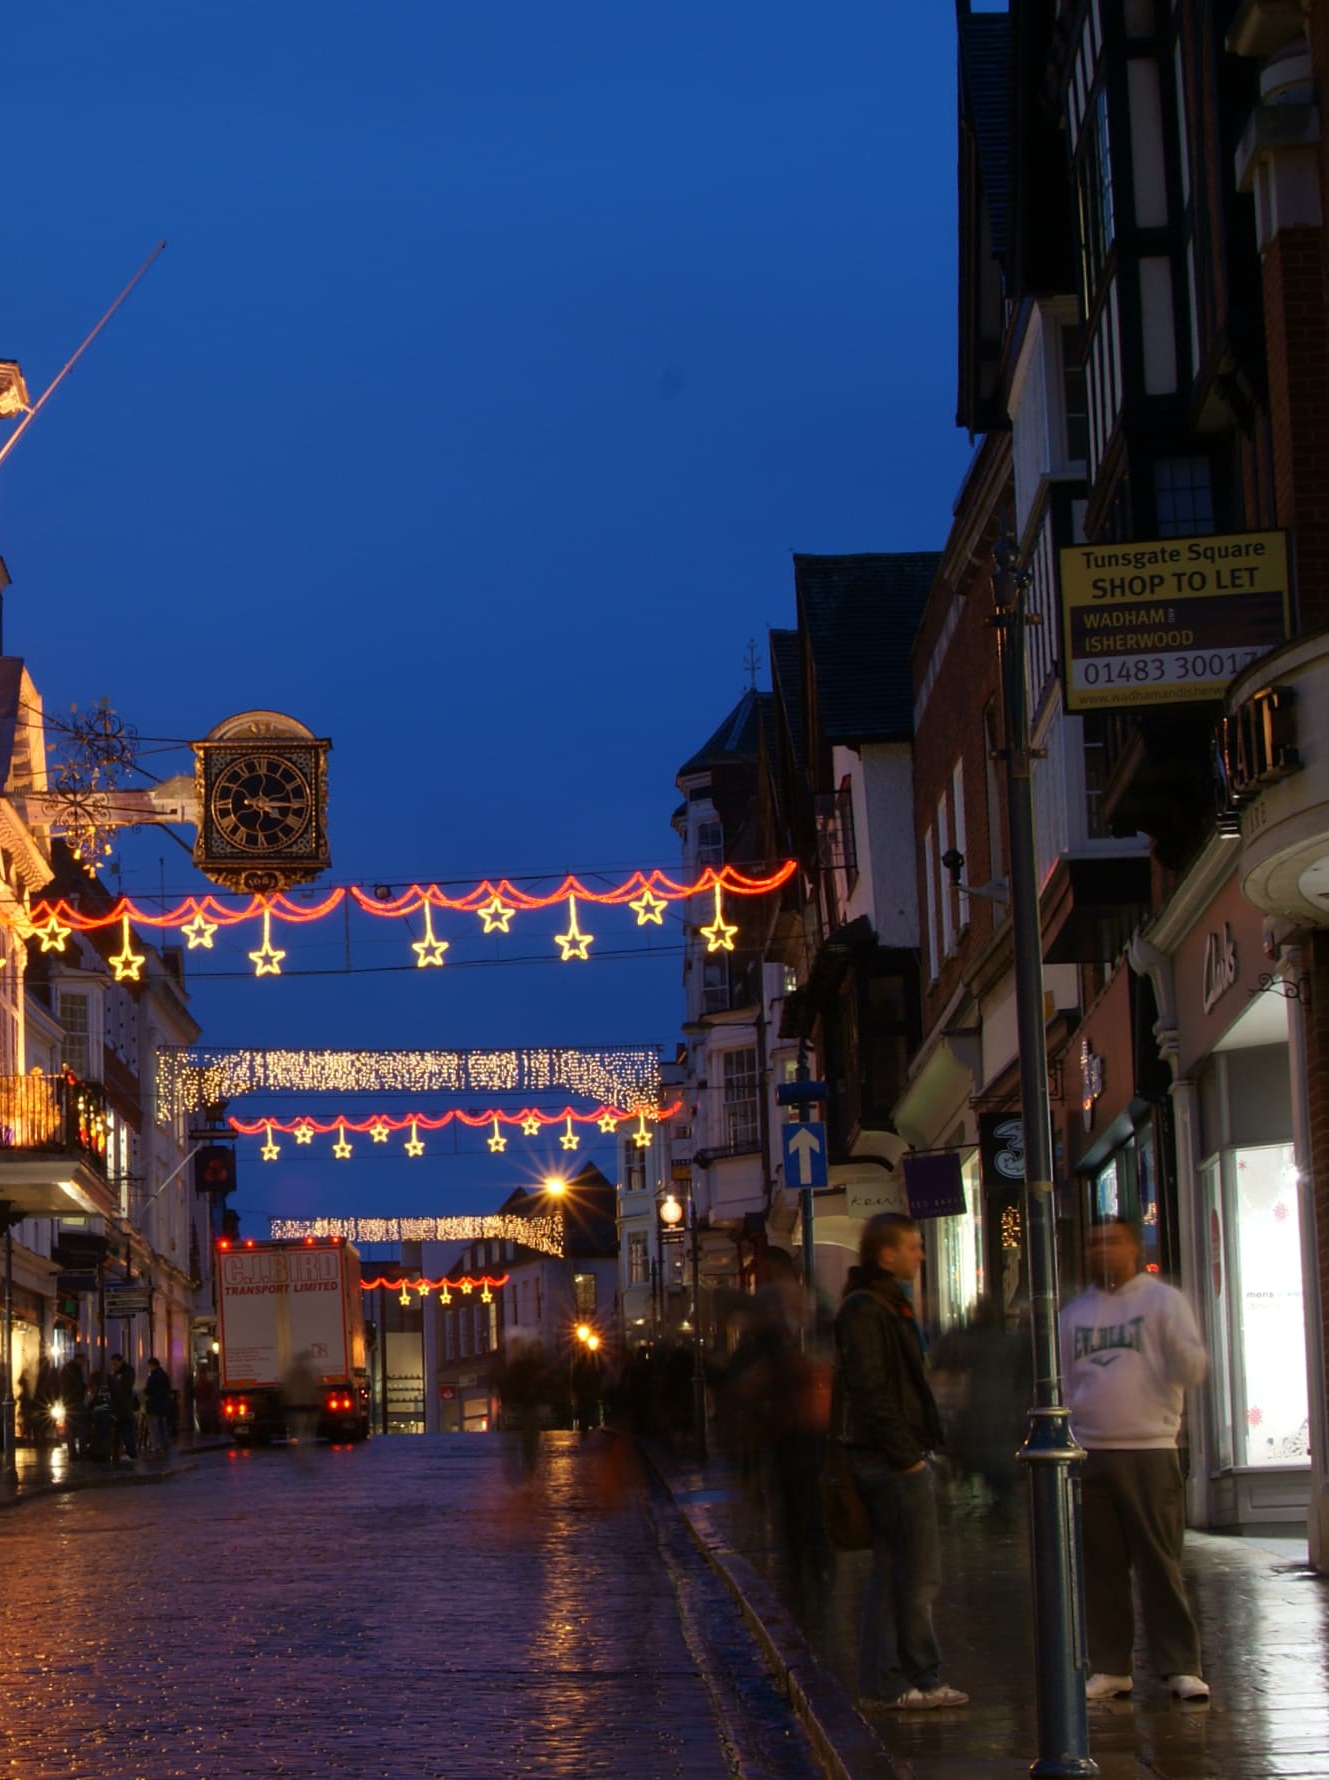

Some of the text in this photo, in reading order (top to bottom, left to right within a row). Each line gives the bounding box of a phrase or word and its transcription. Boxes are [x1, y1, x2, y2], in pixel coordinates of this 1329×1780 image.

[1081, 542, 1265, 569] Tunsgate Square
[1091, 567, 1259, 599] SHOP TO LET
[1083, 607, 1165, 629] WADHAM
[1085, 629, 1194, 652] ISHERWOOD
[1083, 658, 1165, 685] 01483
[225, 1281, 339, 1296] TRANSPORT LIMITED
